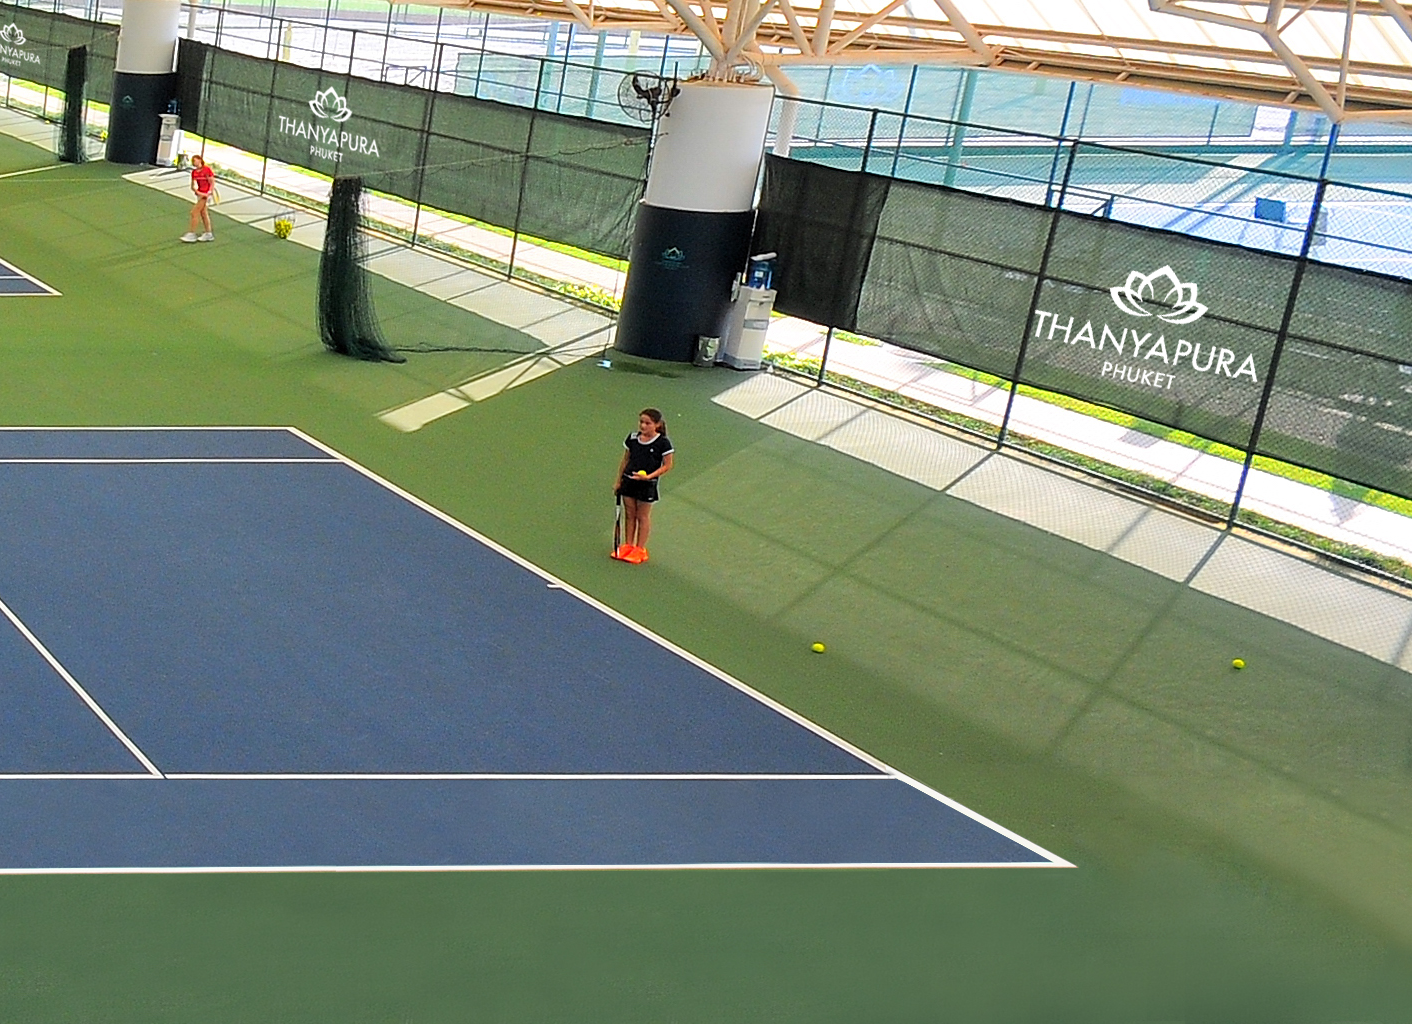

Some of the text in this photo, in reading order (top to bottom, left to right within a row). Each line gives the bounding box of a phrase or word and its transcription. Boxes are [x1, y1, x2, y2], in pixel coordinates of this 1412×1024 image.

[278, 115, 380, 158] THANYAPURA
[309, 144, 344, 163] PHUKET
[1034, 309, 1259, 383] THANYAPURA
[1101, 361, 1176, 390] PHUKET
